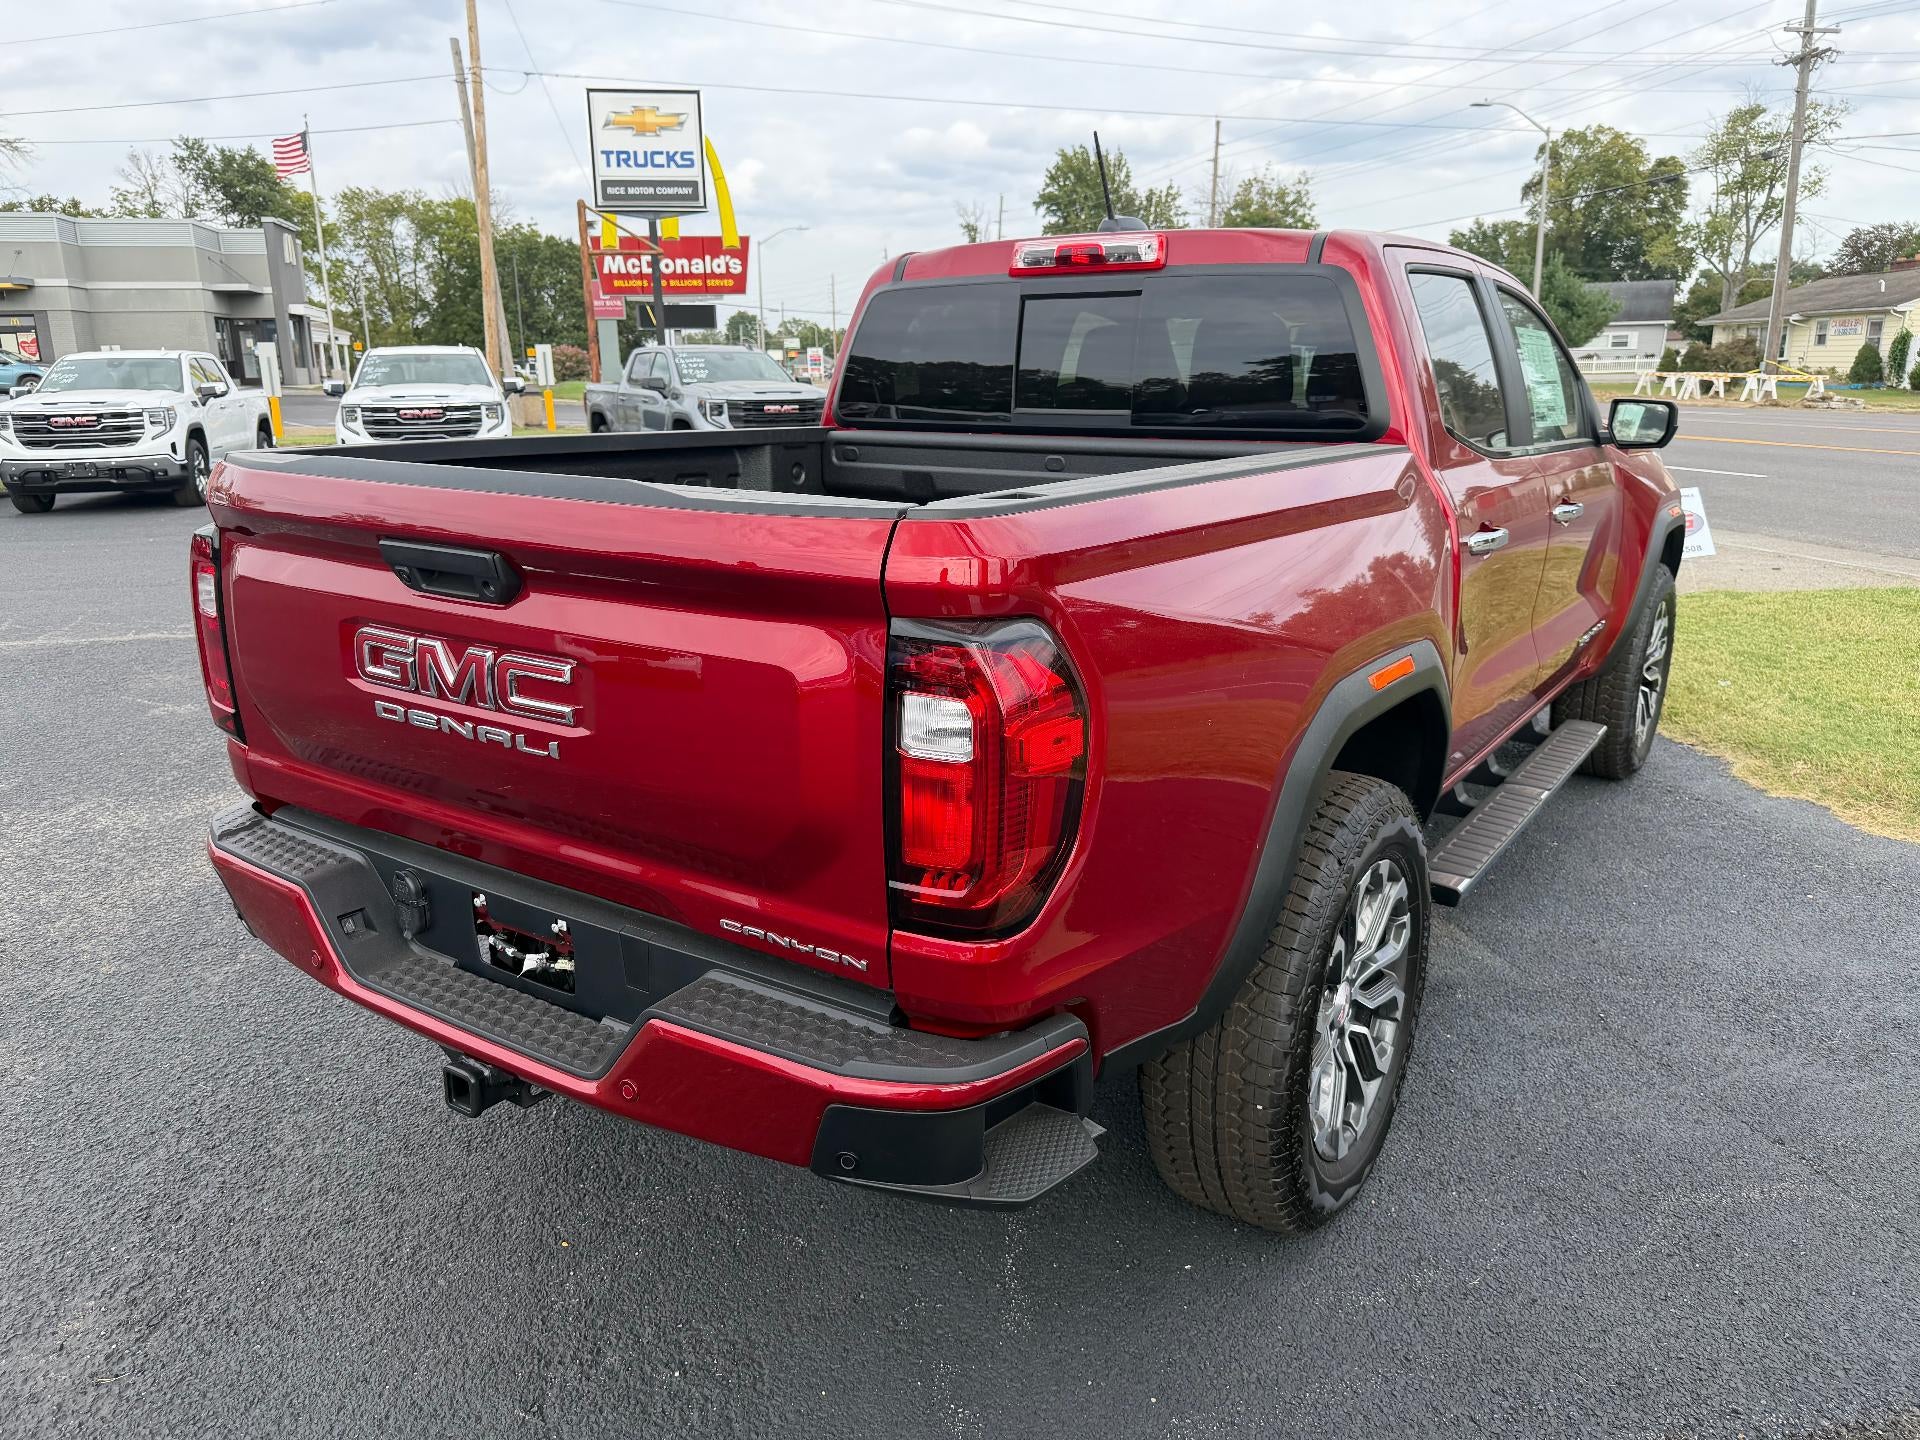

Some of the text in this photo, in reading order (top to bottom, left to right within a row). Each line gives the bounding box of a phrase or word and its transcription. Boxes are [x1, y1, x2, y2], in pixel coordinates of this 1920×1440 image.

[601, 150, 695, 168] TRUCKS
[607, 186, 693, 195] RICE MOTOR COMPANY
[602, 254, 743, 274] McDonald's
[669, 278, 702, 287] BILLIONS
[707, 278, 734, 287] SERVED
[399, 409, 444, 419] GMC
[763, 405, 799, 413] GMC
[50, 416, 98, 427] GMC
[354, 626, 578, 727] GMC
[375, 700, 560, 759] DENALI
[720, 918, 868, 971] CANYON
